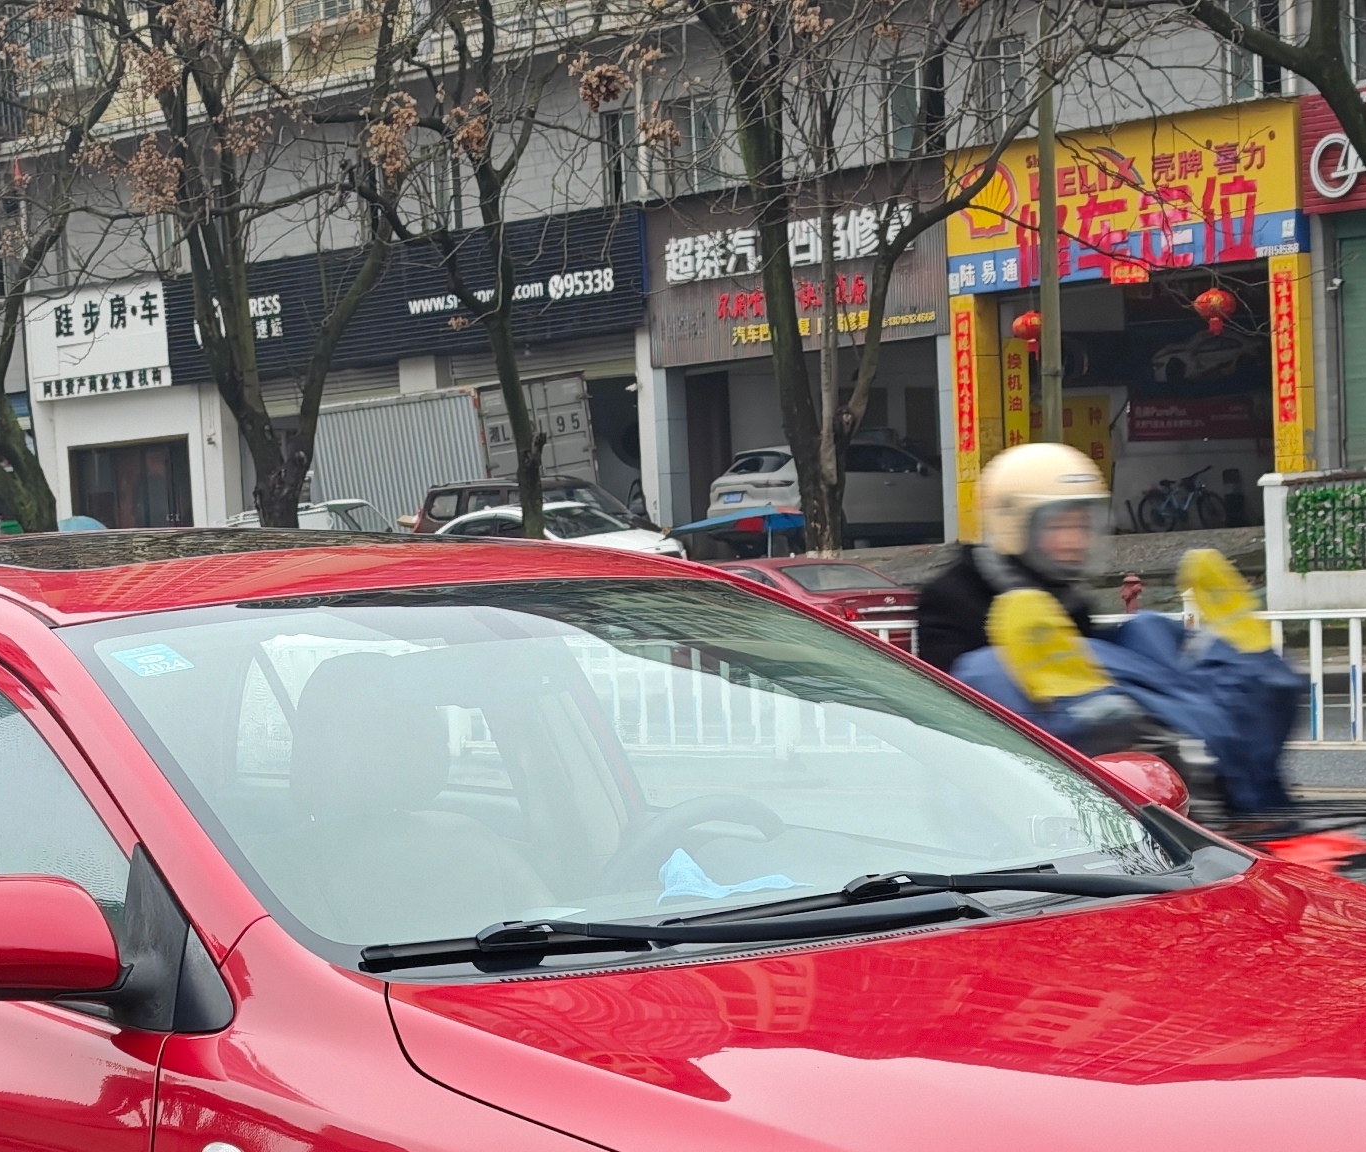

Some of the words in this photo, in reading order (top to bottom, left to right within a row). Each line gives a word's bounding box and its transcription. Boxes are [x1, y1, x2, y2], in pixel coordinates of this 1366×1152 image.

[1153, 150, 1204, 183] 壳牌
[1213, 141, 1267, 175] 喜力
[564, 268, 615, 298] 95338
[958, 257, 1019, 287] 陆易通
[248, 294, 282, 318] RESS
[255, 317, 283, 339] 速运
[43, 367, 162, 399] 阿里资产商业处置机构
[1006, 352, 1023, 412] 换机油
[138, 659, 185, 675] 2024
